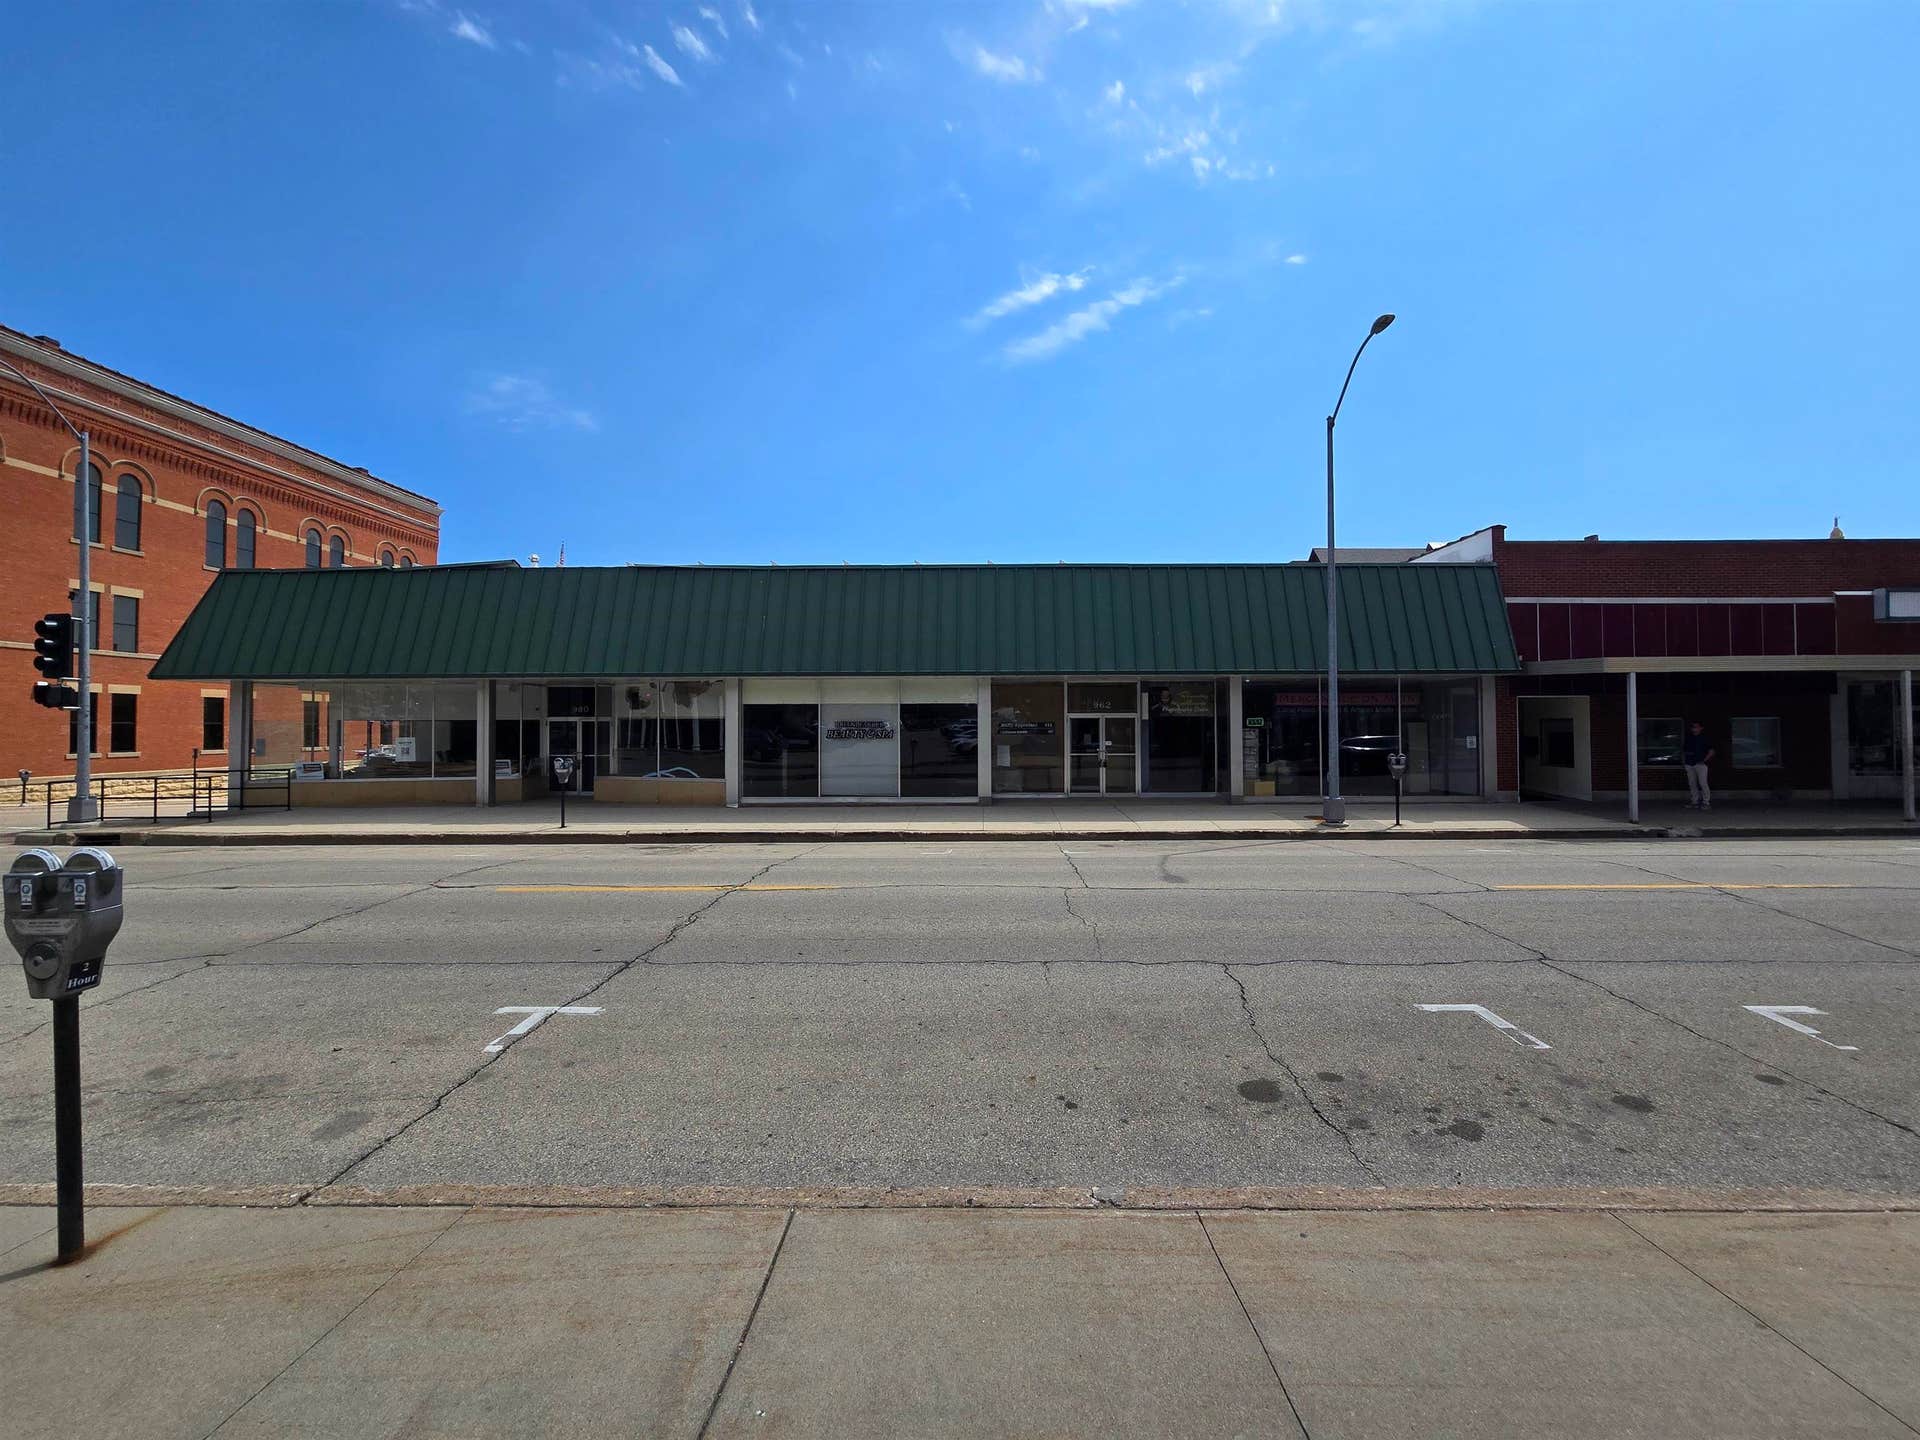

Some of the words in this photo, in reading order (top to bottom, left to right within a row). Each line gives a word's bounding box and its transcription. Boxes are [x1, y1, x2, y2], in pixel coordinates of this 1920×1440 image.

[826, 729, 866, 739] BEAUTY
[82, 962, 90, 972] 2
[67, 974, 97, 989] Hour
